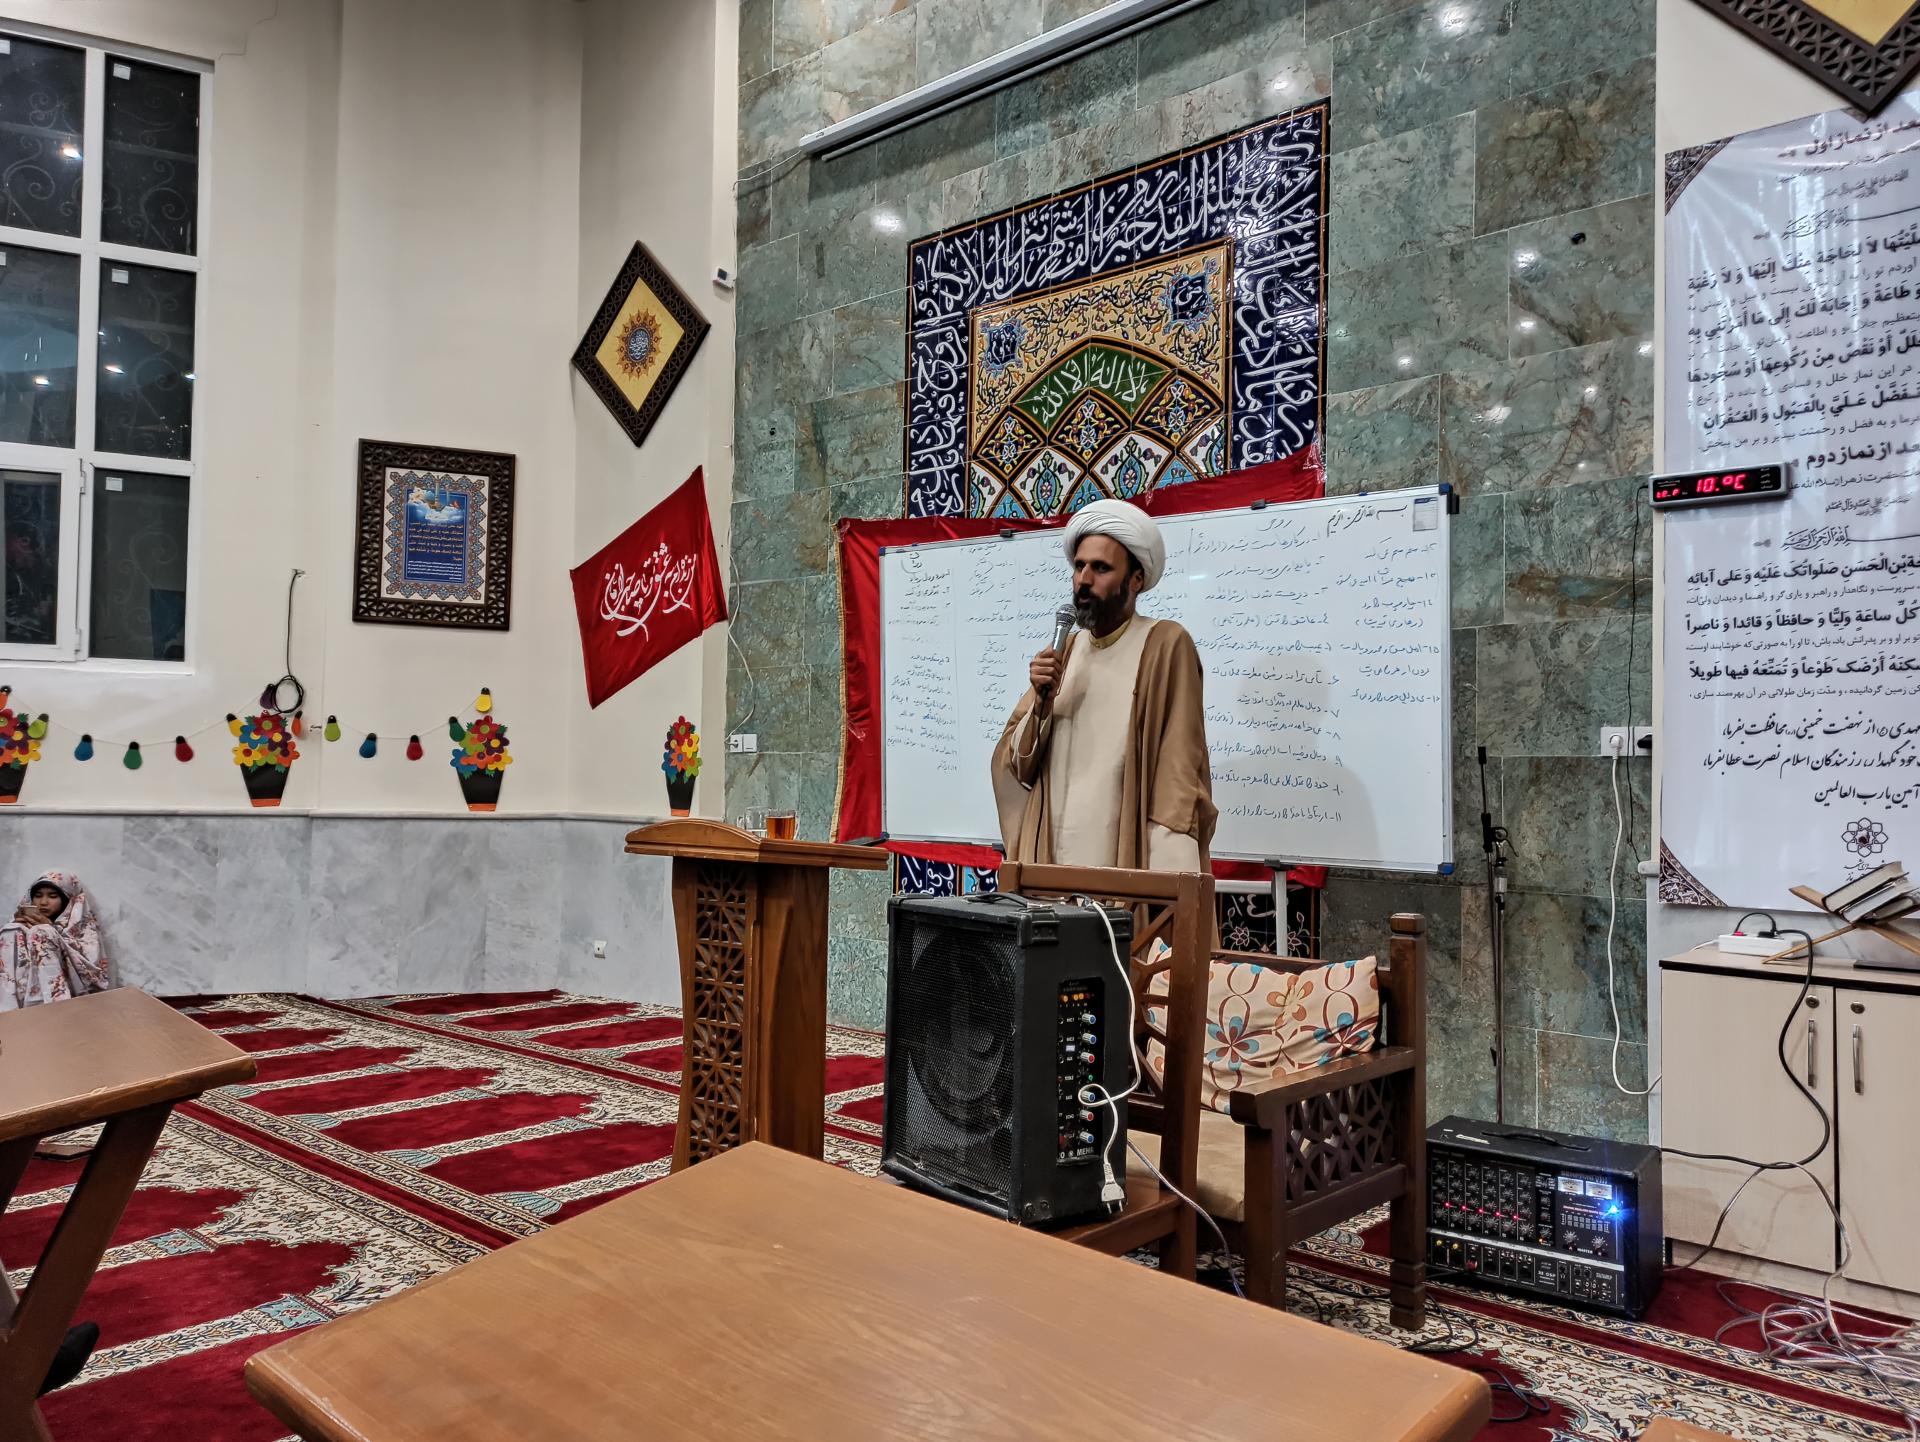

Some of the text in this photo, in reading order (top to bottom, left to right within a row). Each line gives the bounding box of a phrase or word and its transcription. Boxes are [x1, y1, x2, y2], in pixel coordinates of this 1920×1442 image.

[1806, 441, 1892, 470] از نماز دوم
[1746, 686, 1756, 699] آن
[1758, 691, 1766, 699] در
[1768, 687, 1795, 699] طولانی
[1797, 687, 1815, 698] زمان
[1885, 687, 1906, 696] زمین
[1744, 712, 1787, 736] محافظت
[1796, 708, 1823, 739] خمینی
[1823, 710, 1863, 735] نهضت
[1863, 718, 1875, 735] از
[1726, 753, 1743, 766] عطا
[1742, 744, 1781, 771] نصرت
[1780, 753, 1811, 780] اسلام
[1811, 748, 1862, 771] رزمندگان
[1899, 745, 1917, 768] خود
[1815, 779, 1856, 807] العالمین
[1892, 782, 1920, 809] آمین
